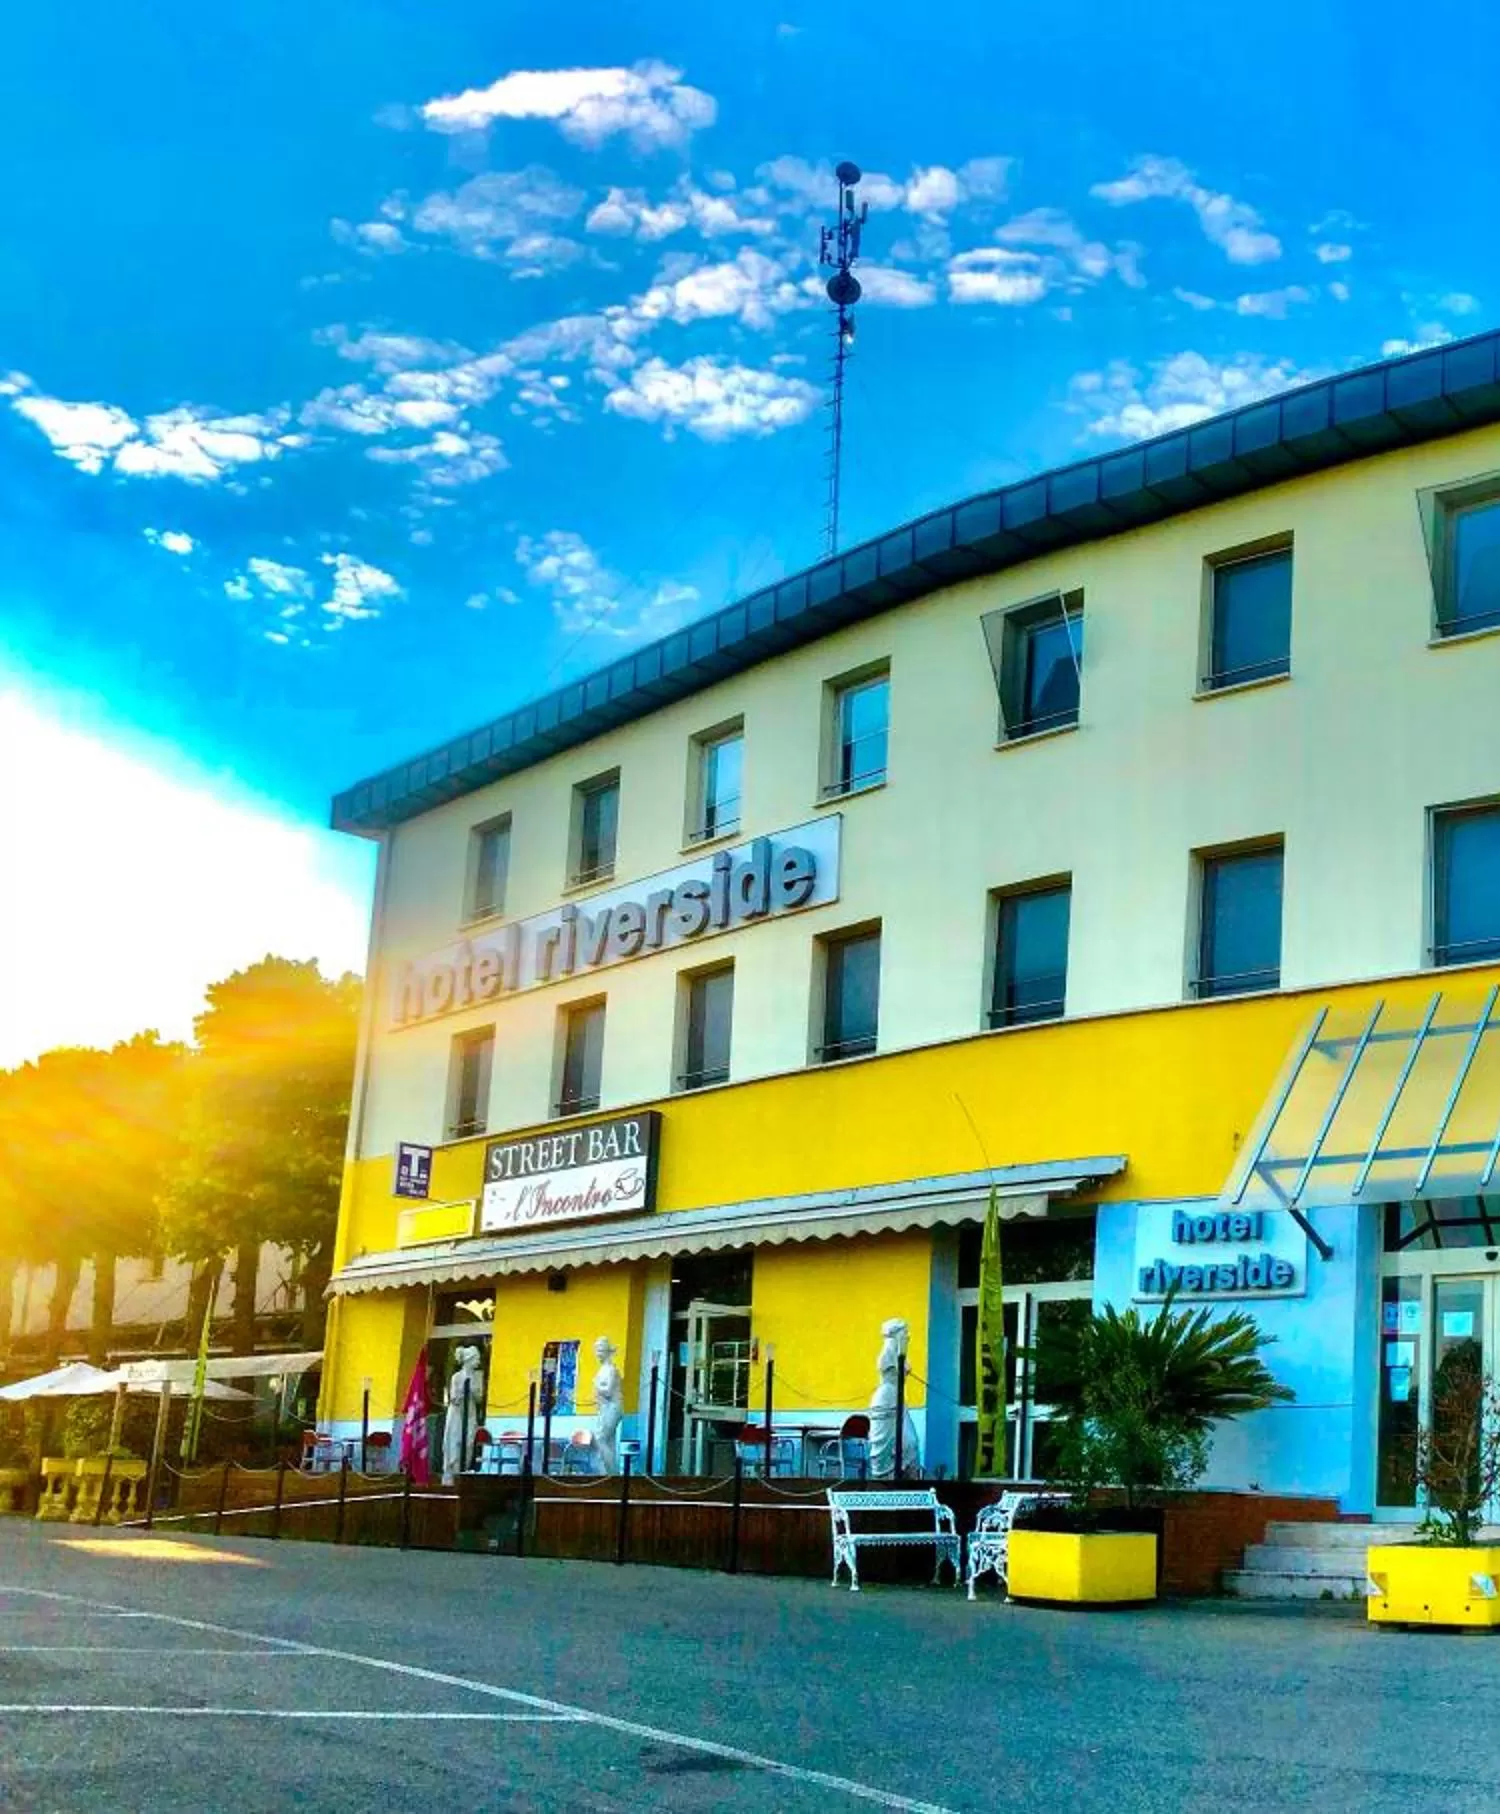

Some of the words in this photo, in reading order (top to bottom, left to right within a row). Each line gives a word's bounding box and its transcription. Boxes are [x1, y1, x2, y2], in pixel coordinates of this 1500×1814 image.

[390, 922, 522, 1025] hotel
[535, 836, 817, 983] riverside
[490, 1131, 582, 1180] STREET
[587, 1121, 641, 1162] BAR
[1172, 1209, 1264, 1244] hotel
[1139, 1252, 1296, 1294] riverside
